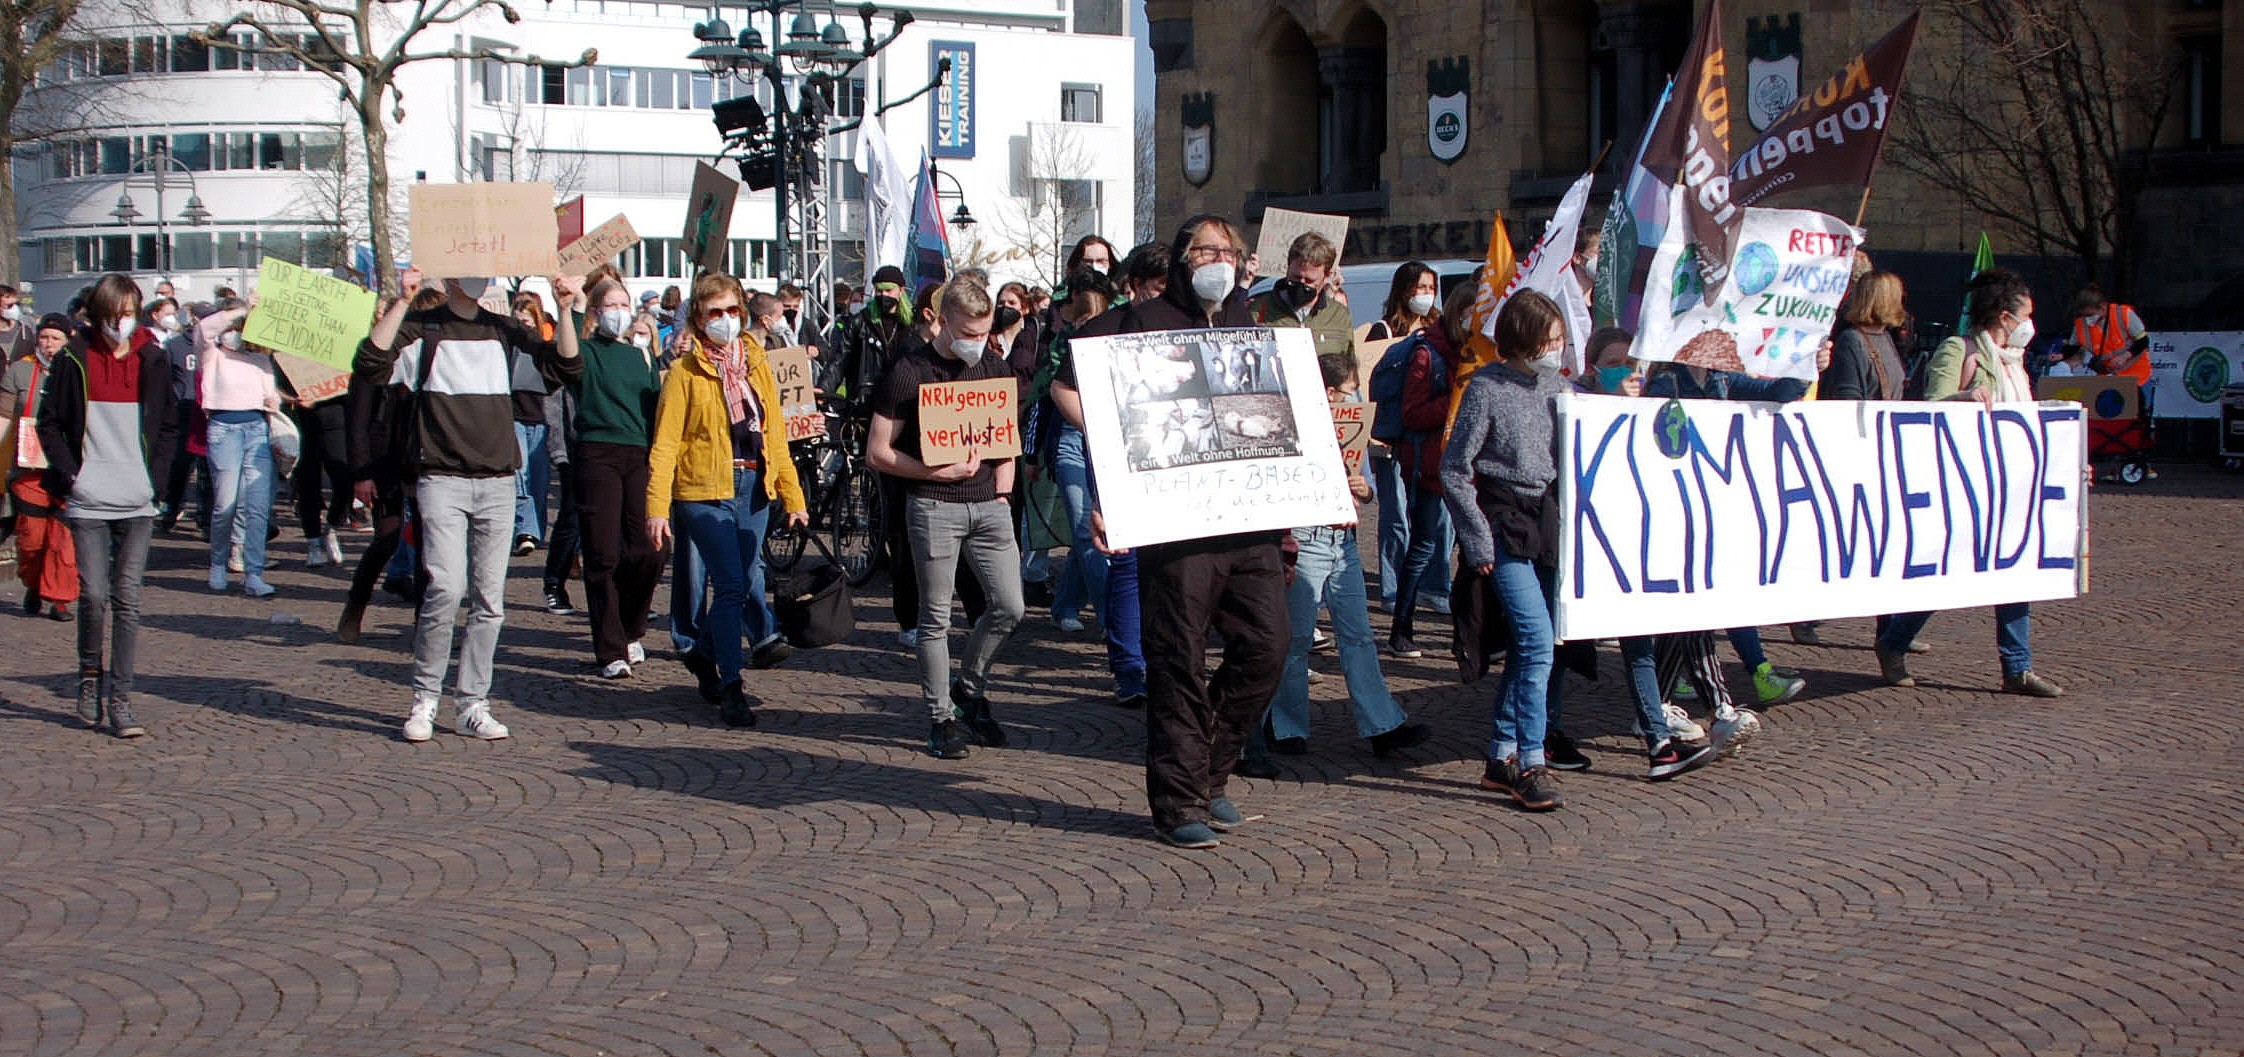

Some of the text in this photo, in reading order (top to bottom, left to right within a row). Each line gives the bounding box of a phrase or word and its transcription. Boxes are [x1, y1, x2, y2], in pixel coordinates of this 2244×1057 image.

[957, 50, 970, 148] TRAINING
[1789, 228, 1854, 258] RETTE
[268, 261, 349, 302] OUR EARTH
[1782, 263, 1848, 294] UNSERE
[262, 296, 348, 337] HOTTER THAN
[258, 313, 335, 361] ZENDAYA
[1142, 335, 1169, 347] Welt
[1173, 333, 1205, 345] ohne
[1206, 329, 1256, 344] Mitgefühl
[2153, 341, 2175, 353] Erde
[777, 362, 801, 385] ÜR
[779, 385, 805, 407] FT
[922, 385, 1007, 413] NRW genug
[1336, 426, 1346, 440] S
[1172, 450, 1200, 465] Welt
[1203, 448, 1233, 462] ohne
[1341, 449, 1361, 468] P!
